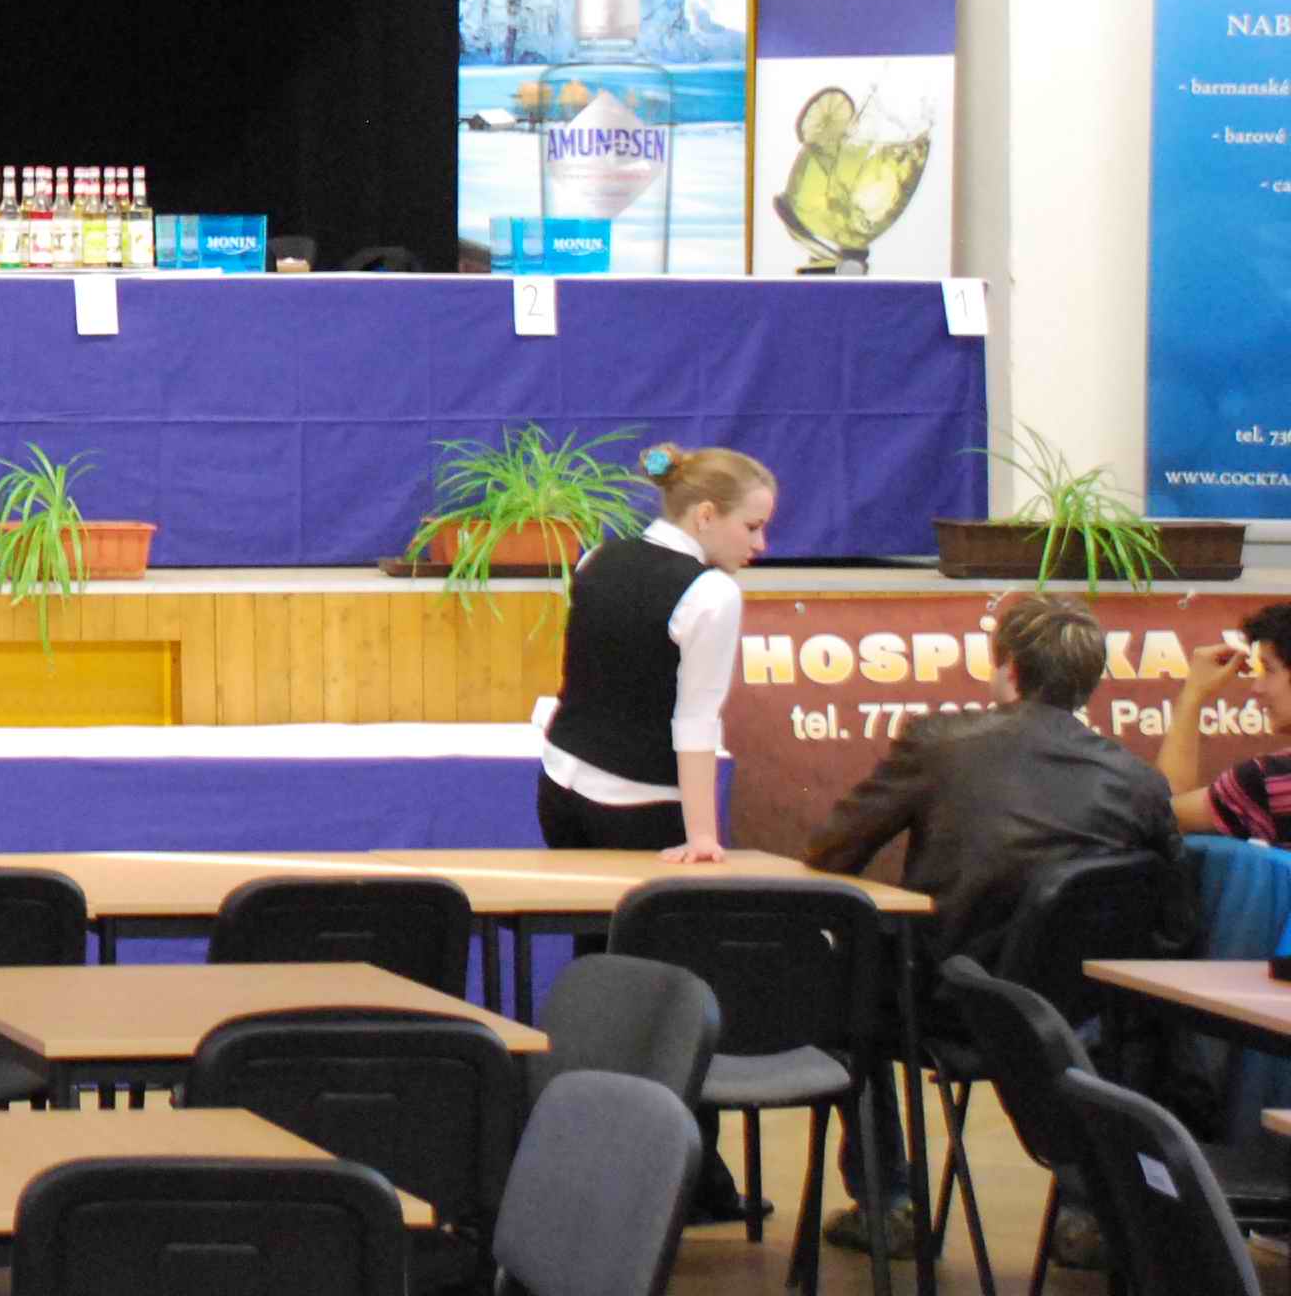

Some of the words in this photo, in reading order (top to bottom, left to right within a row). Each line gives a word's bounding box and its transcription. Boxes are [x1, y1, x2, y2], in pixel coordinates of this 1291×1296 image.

[547, 128, 665, 162] AMUNDSEN
[205, 235, 258, 250] MONIN
[522, 284, 546, 317] 2
[741, 615, 1190, 685] HOSPŮKA
[791, 703, 850, 740] tel.
